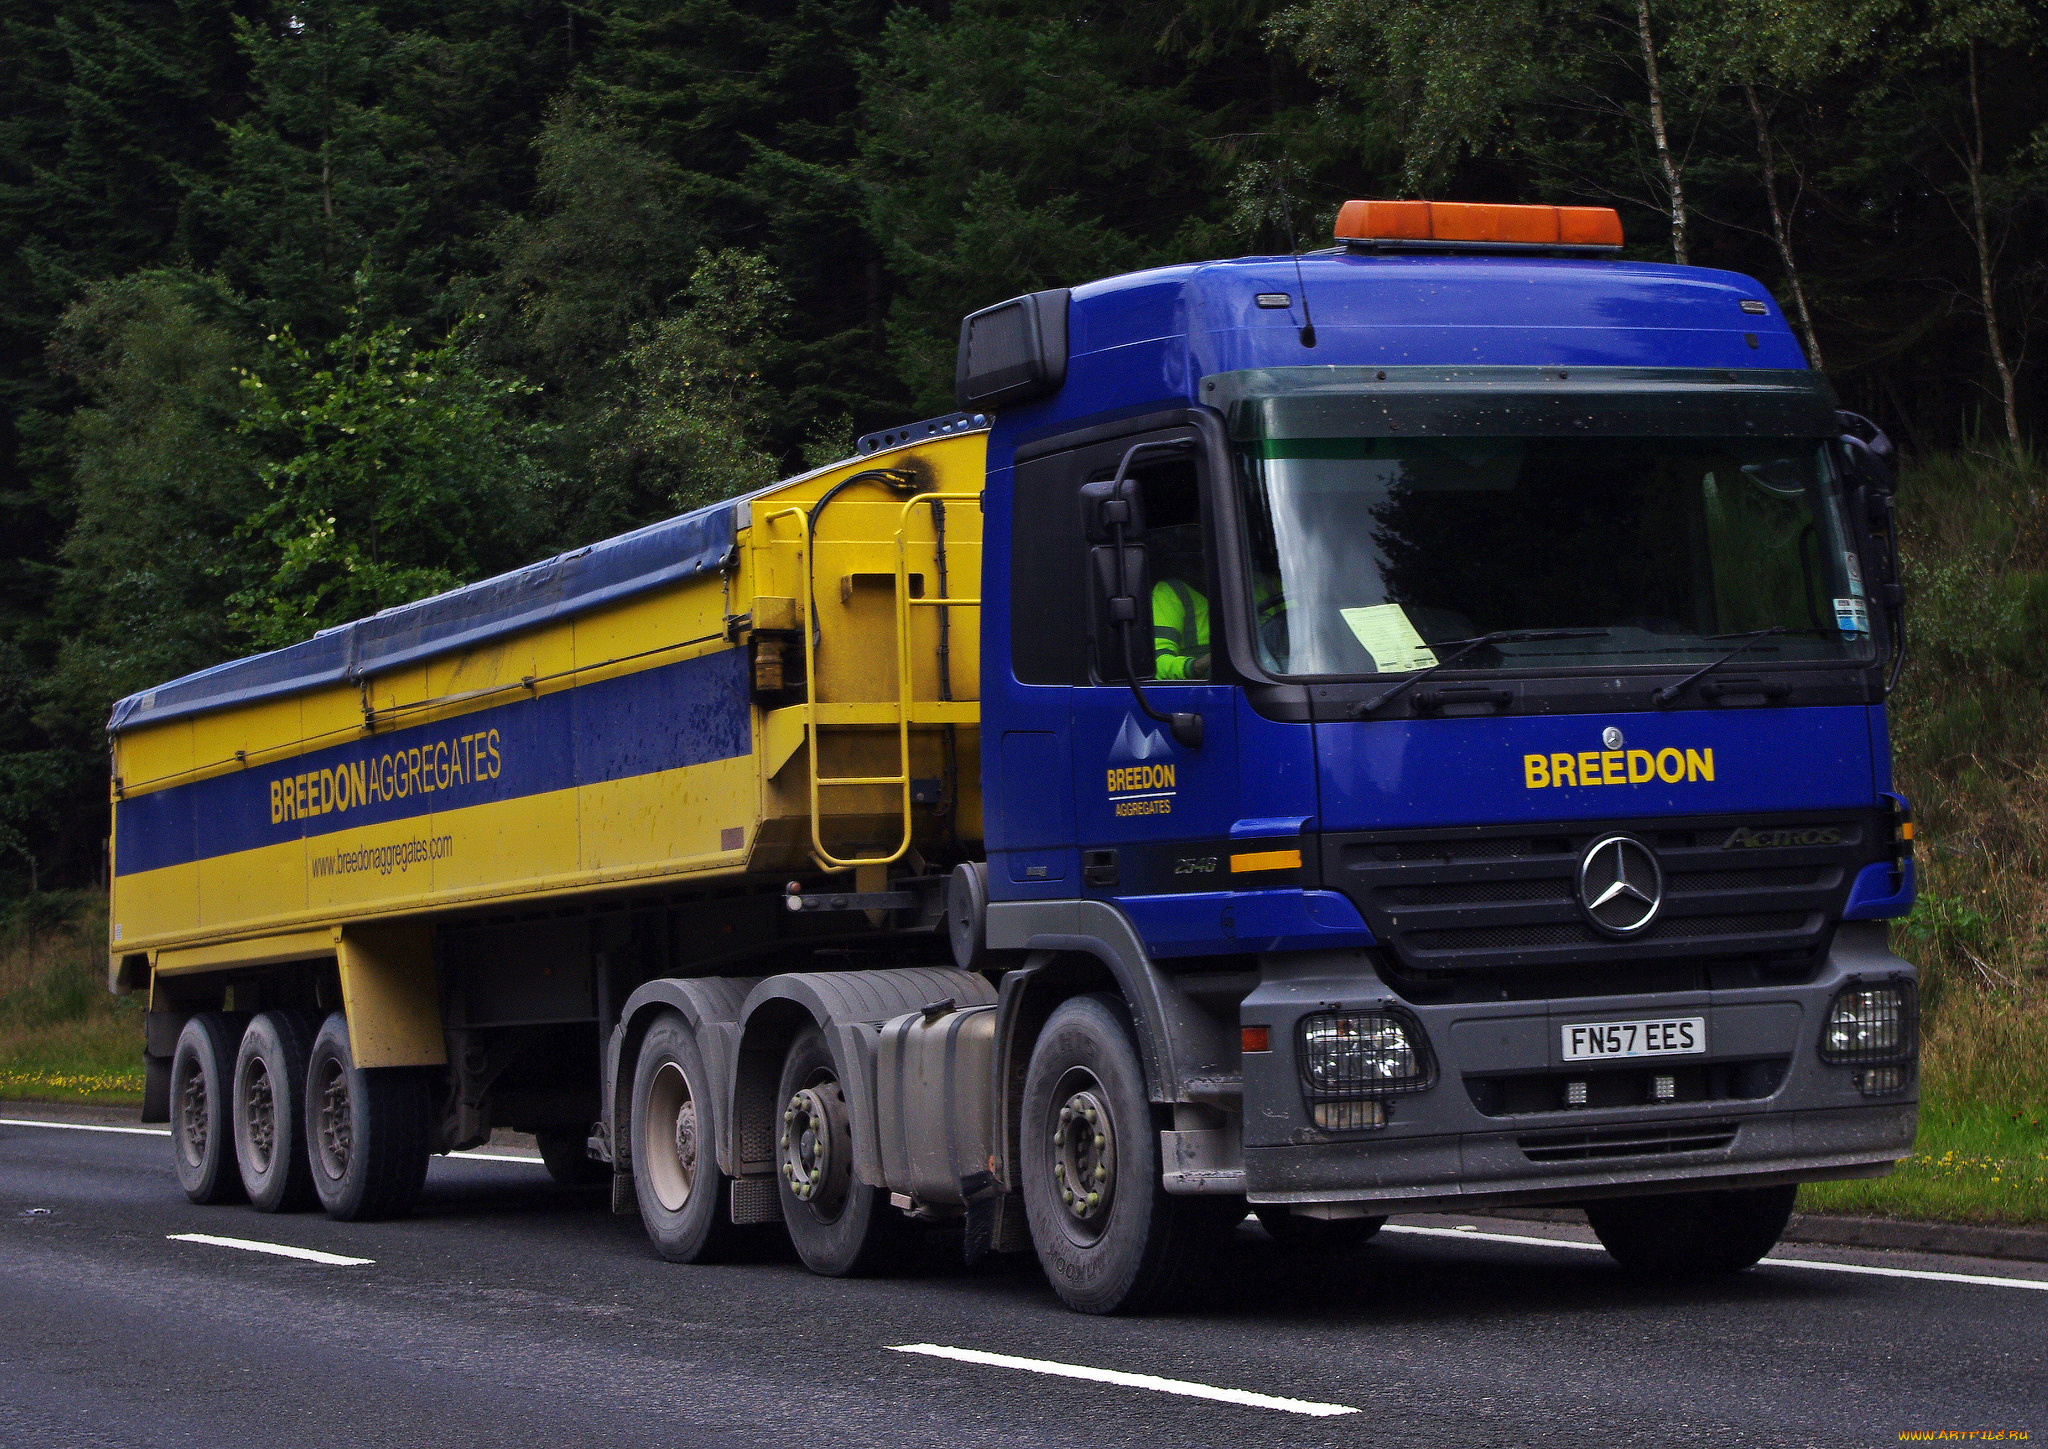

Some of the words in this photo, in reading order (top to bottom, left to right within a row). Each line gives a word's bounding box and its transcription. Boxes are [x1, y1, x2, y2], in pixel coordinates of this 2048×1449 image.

[1107, 764, 1176, 792] BREEDON
[1524, 746, 1716, 789] BREEDON
[1115, 799, 1171, 817] AGGREGATES
[311, 835, 453, 877] www.breedonaggregates.com
[1572, 1025, 1639, 1055] FN57
[1645, 1022, 1695, 1051] EES
